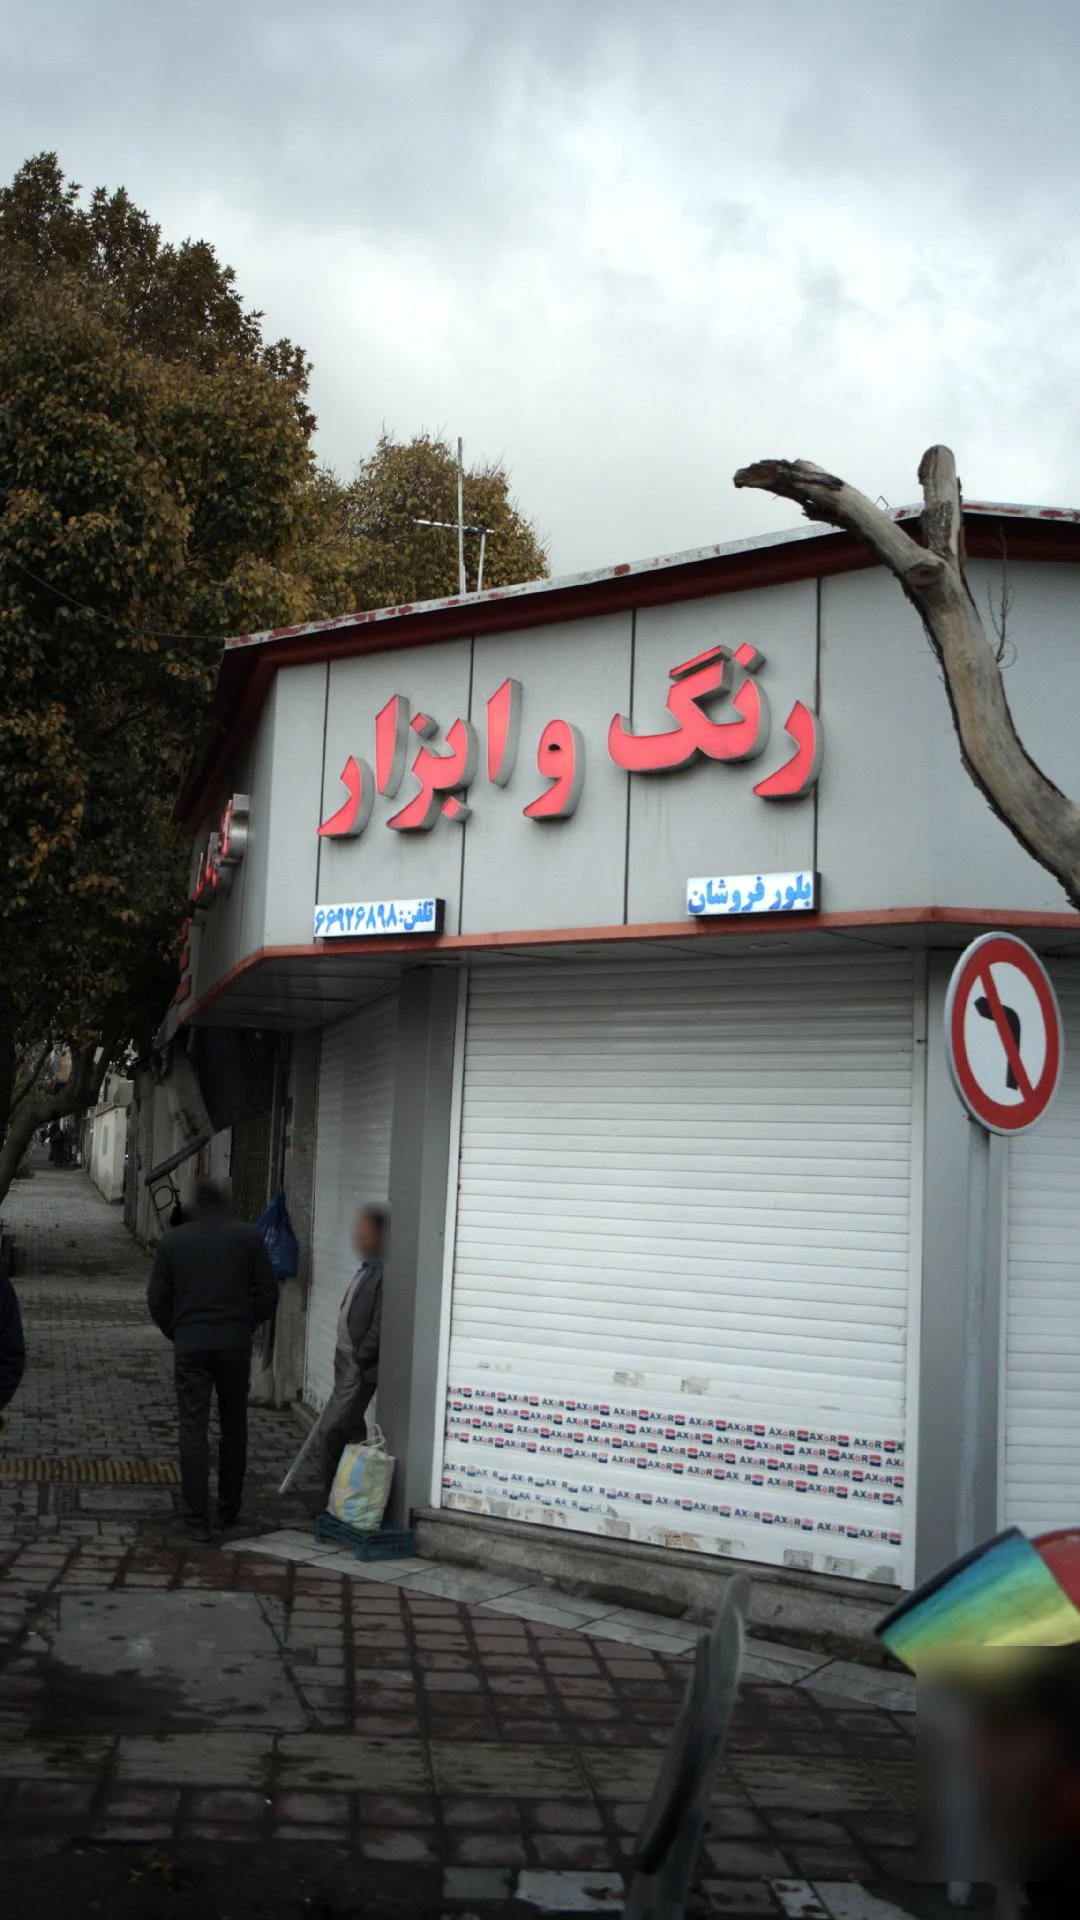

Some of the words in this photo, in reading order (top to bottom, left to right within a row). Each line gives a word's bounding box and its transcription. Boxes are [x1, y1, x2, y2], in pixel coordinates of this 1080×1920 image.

[317, 677, 520, 838] ابزار
[523, 719, 582, 819] و
[608, 642, 821, 798] رنگ
